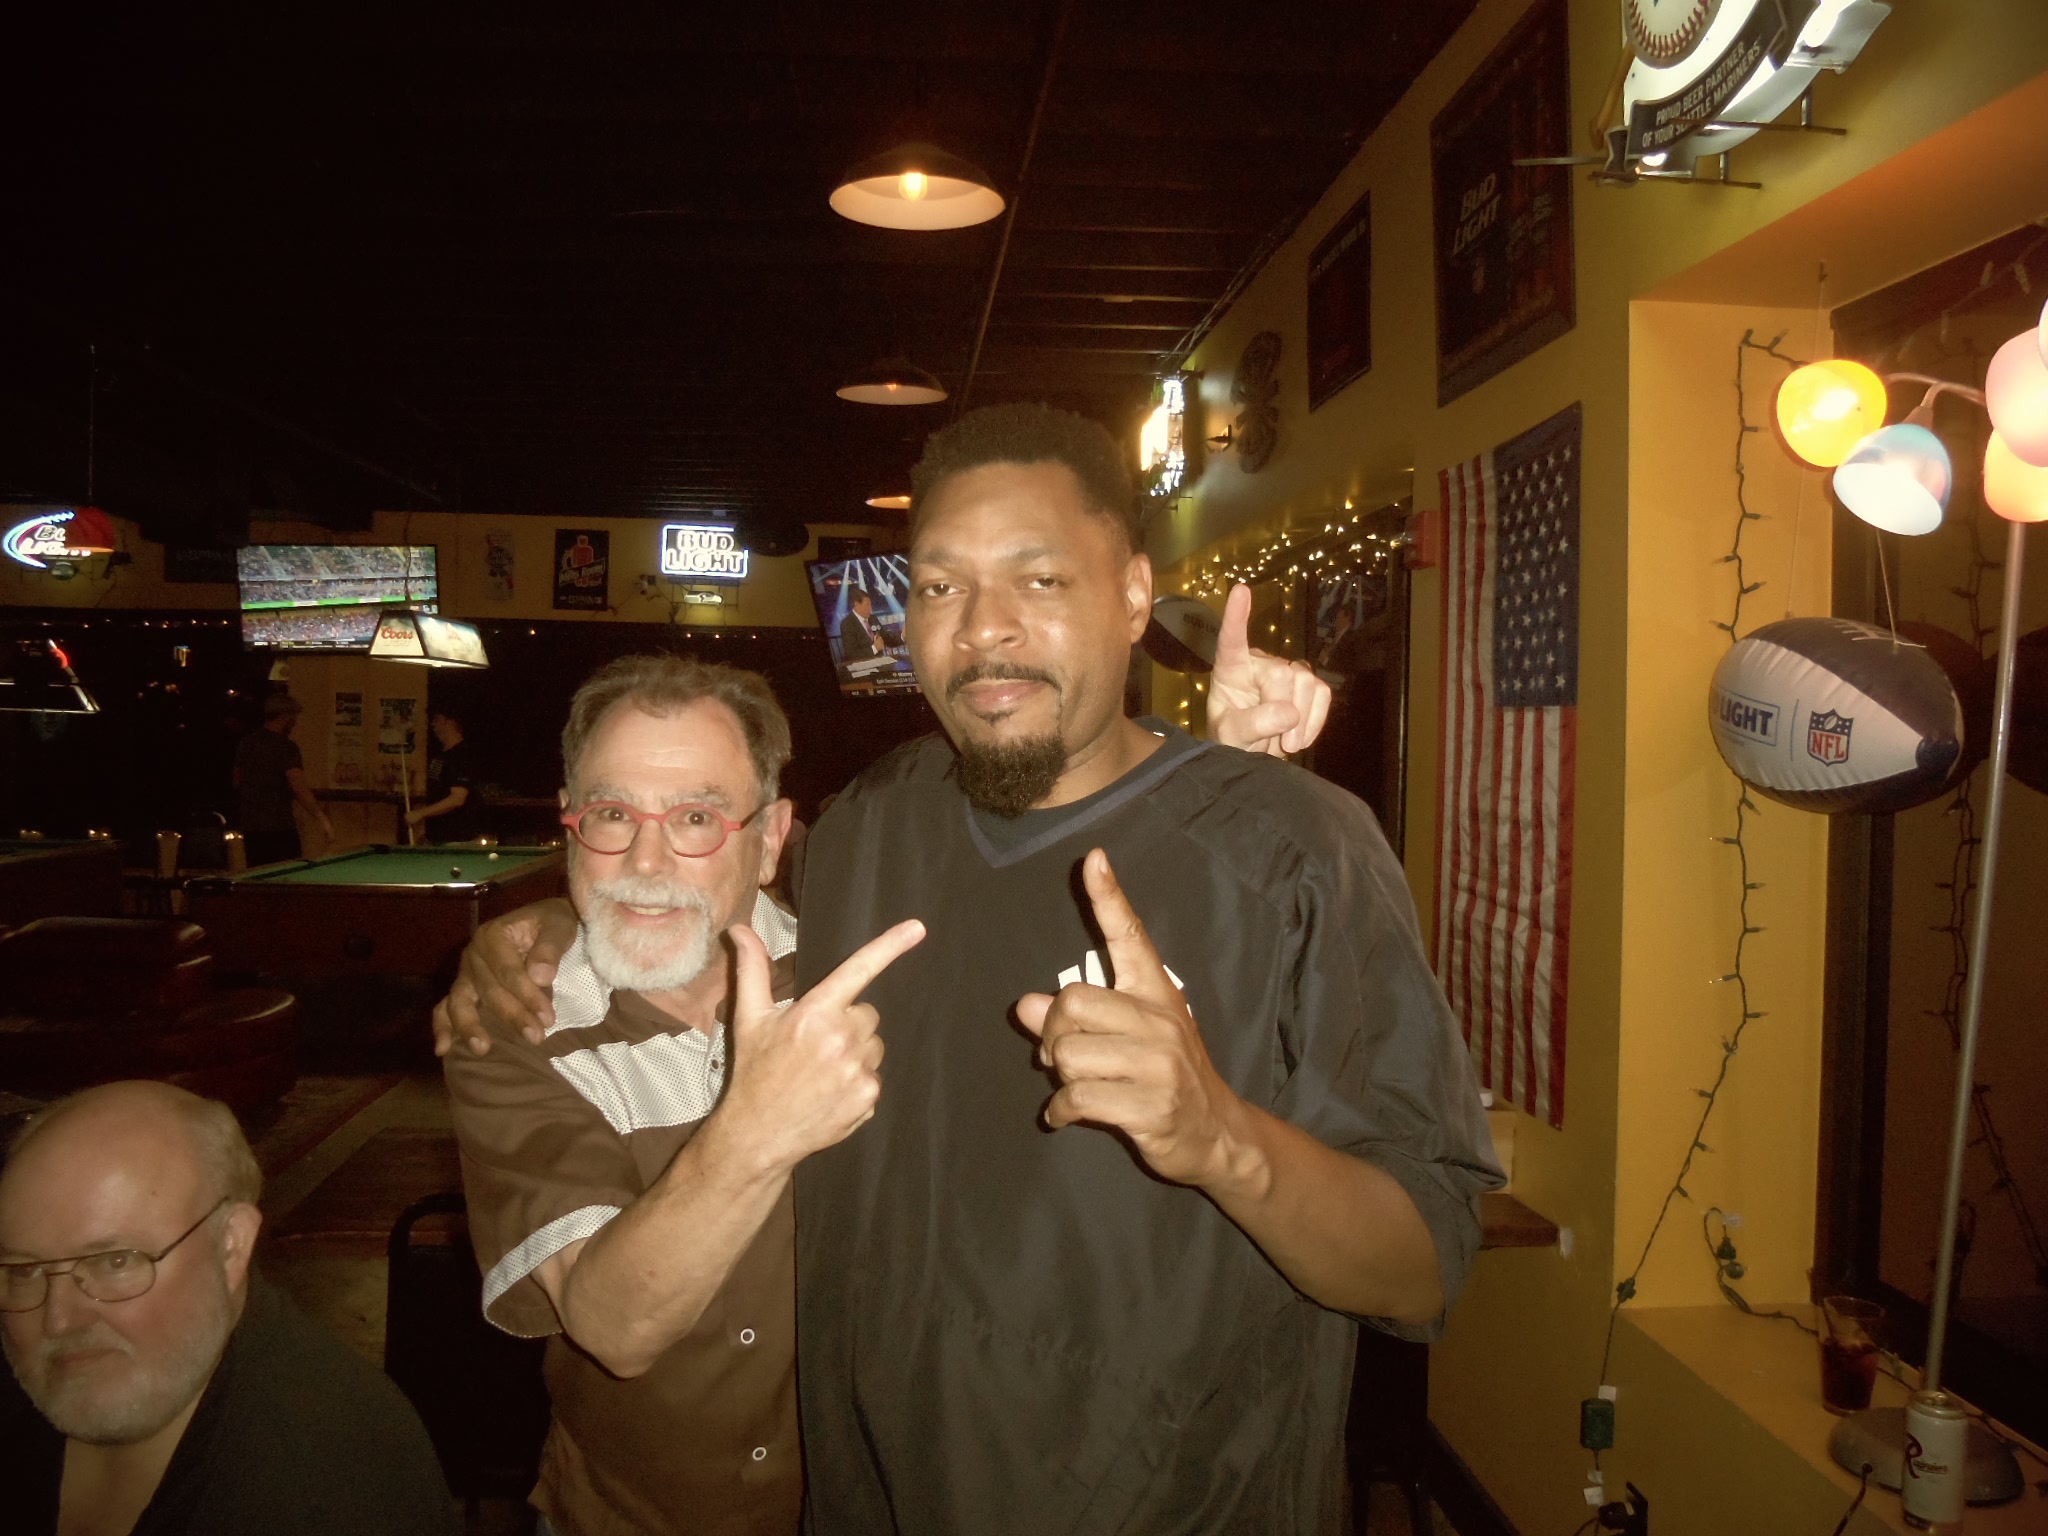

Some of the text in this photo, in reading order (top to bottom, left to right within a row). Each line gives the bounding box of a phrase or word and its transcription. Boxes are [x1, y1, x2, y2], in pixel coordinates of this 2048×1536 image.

[1642, 131, 1653, 148] OF
[1654, 123, 1674, 145] YOUR
[1713, 40, 1761, 106] MARINERS
[1656, 41, 1745, 126] PROUD BEER PARTNER
[1460, 172, 1496, 222] BUD
[1452, 194, 1501, 257] LIGHT
[34, 525, 66, 542] BU
[677, 530, 734, 551] BUD
[666, 548, 744, 572] LIGHT
[381, 626, 414, 640] Coors
[1720, 697, 1773, 735] LIGHT
[1812, 732, 1846, 760] NFL
